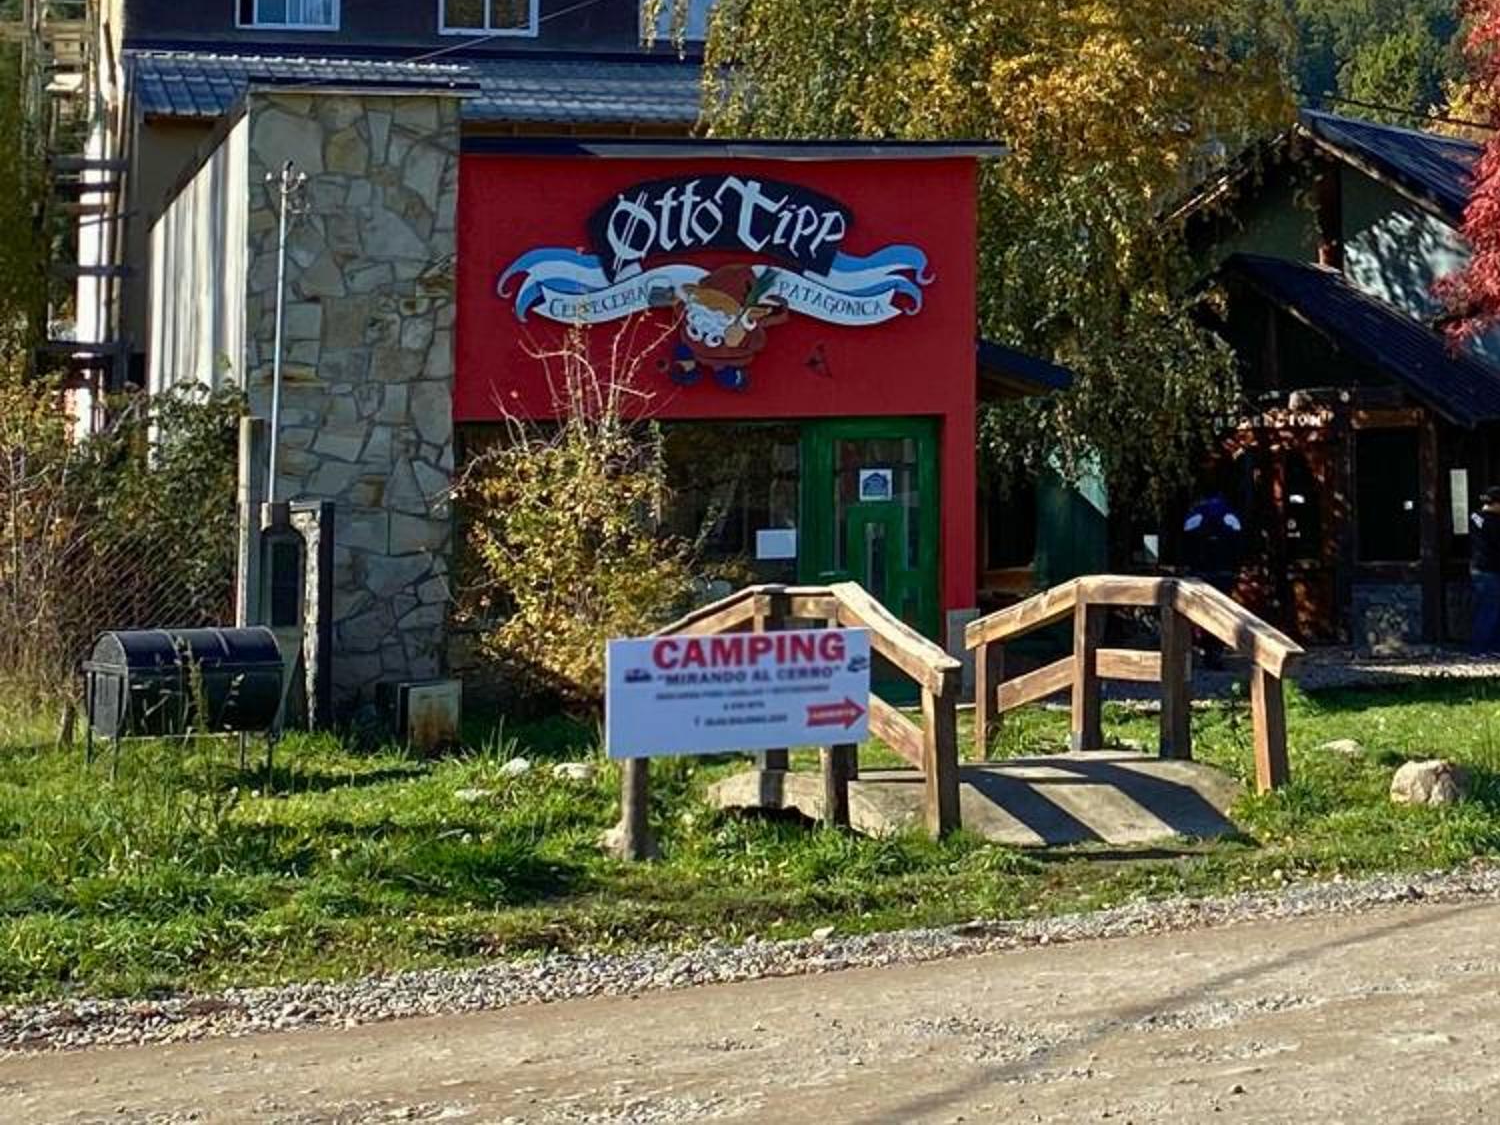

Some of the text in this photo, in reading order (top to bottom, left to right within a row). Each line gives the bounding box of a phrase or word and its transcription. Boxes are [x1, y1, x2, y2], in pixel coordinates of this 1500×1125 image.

[714, 176, 846, 259] Tipp
[779, 281, 885, 316] PATAGONICA
[653, 632, 845, 670] CAMPING
[752, 668, 770, 682] AL
